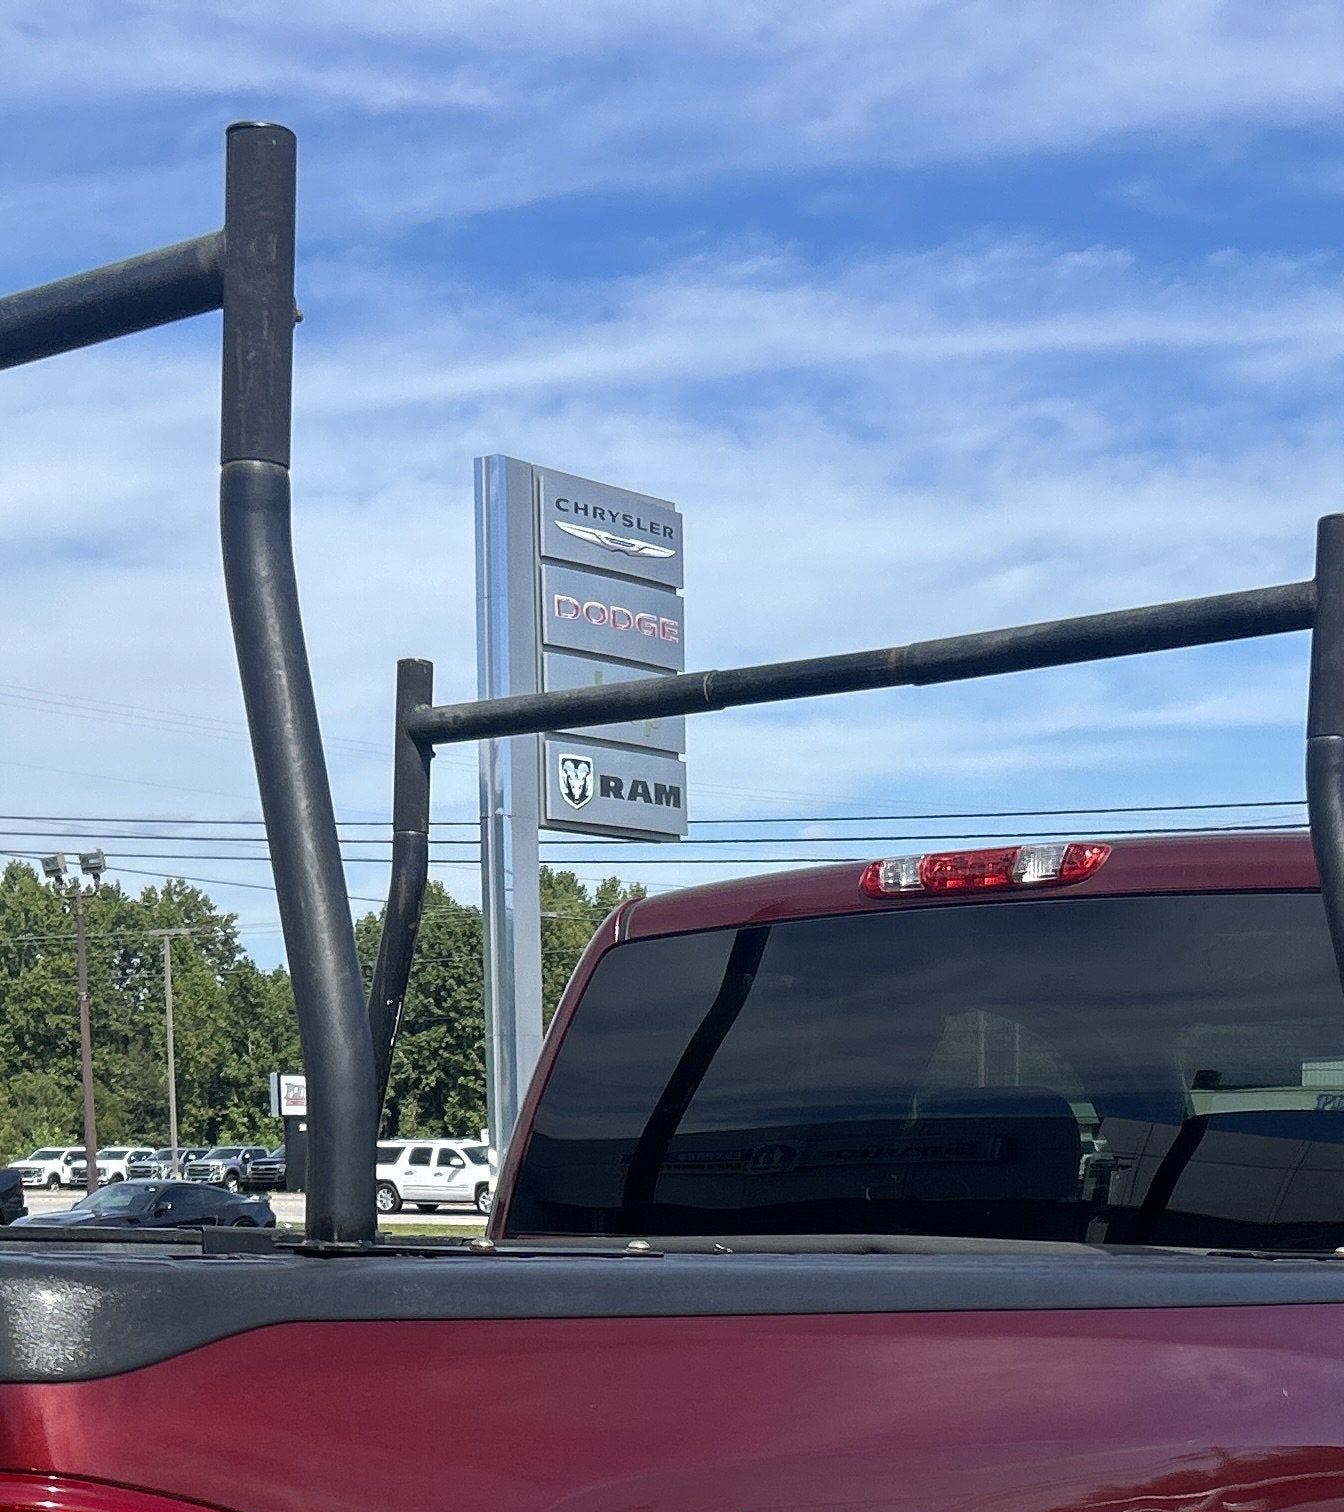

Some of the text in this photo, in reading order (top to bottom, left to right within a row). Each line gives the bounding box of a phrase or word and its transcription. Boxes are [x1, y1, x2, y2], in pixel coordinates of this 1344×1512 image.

[555, 498, 674, 540] CHRYSLER
[553, 594, 679, 643] DODGE
[599, 774, 682, 809] RAM
